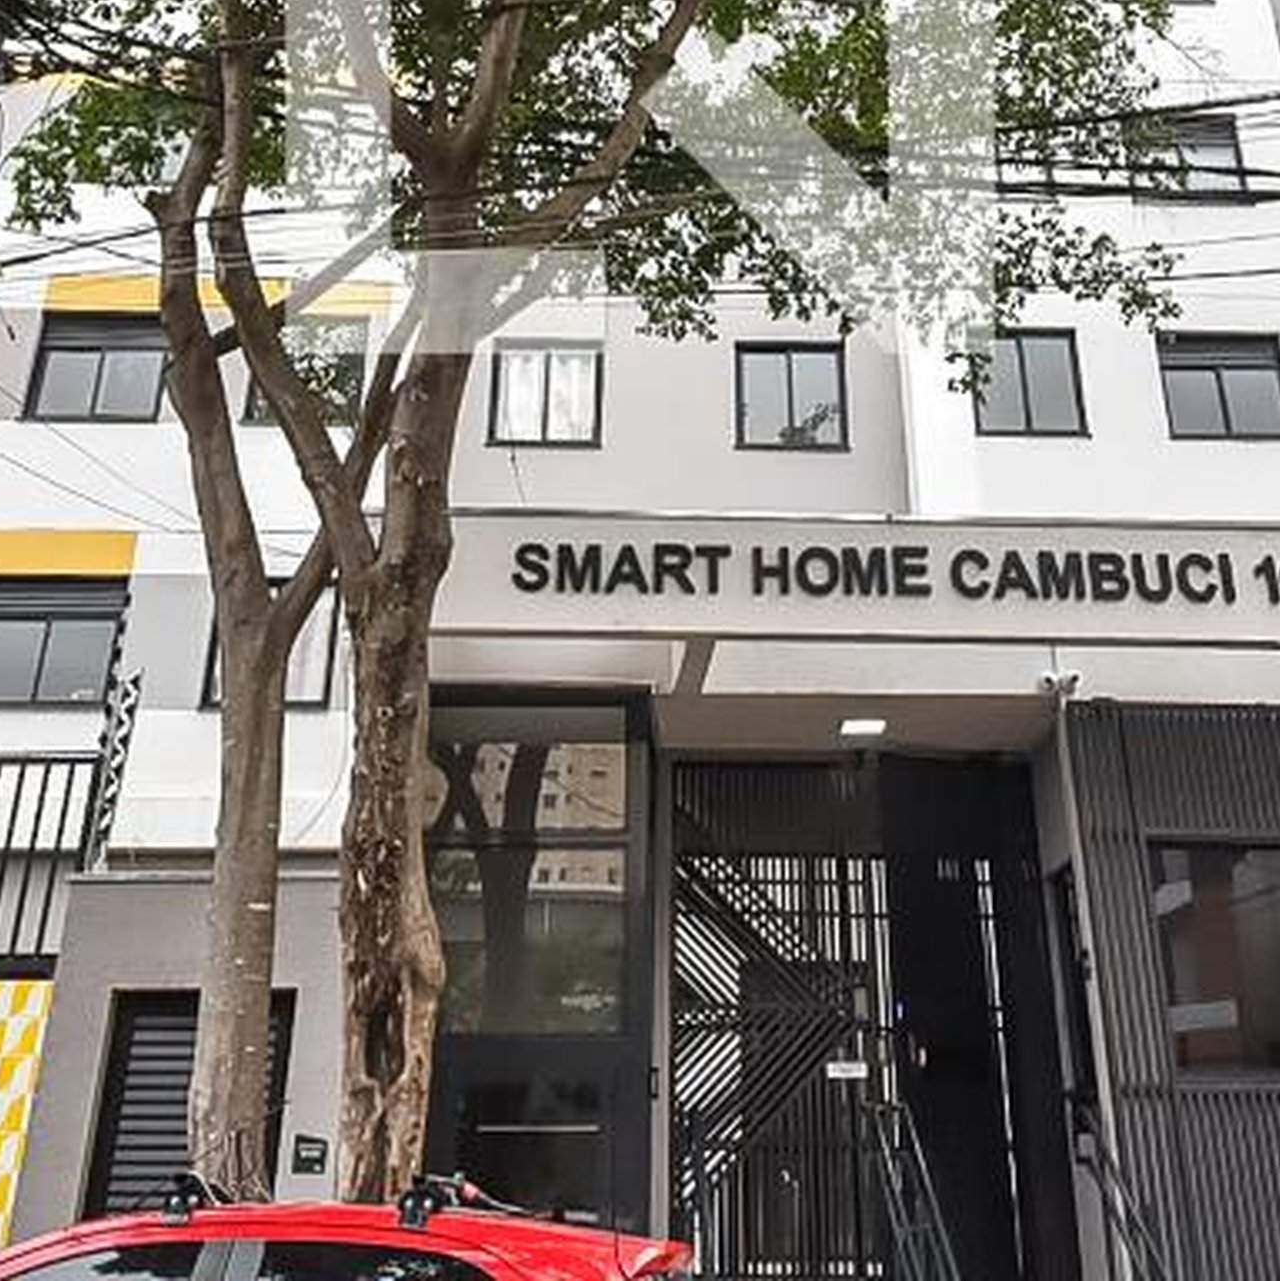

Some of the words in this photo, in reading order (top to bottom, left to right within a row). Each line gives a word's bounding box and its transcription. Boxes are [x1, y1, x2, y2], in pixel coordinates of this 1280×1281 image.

[511, 542, 732, 596] SMART
[751, 545, 932, 598] HOME
[949, 549, 1237, 606] CAMBUCI
